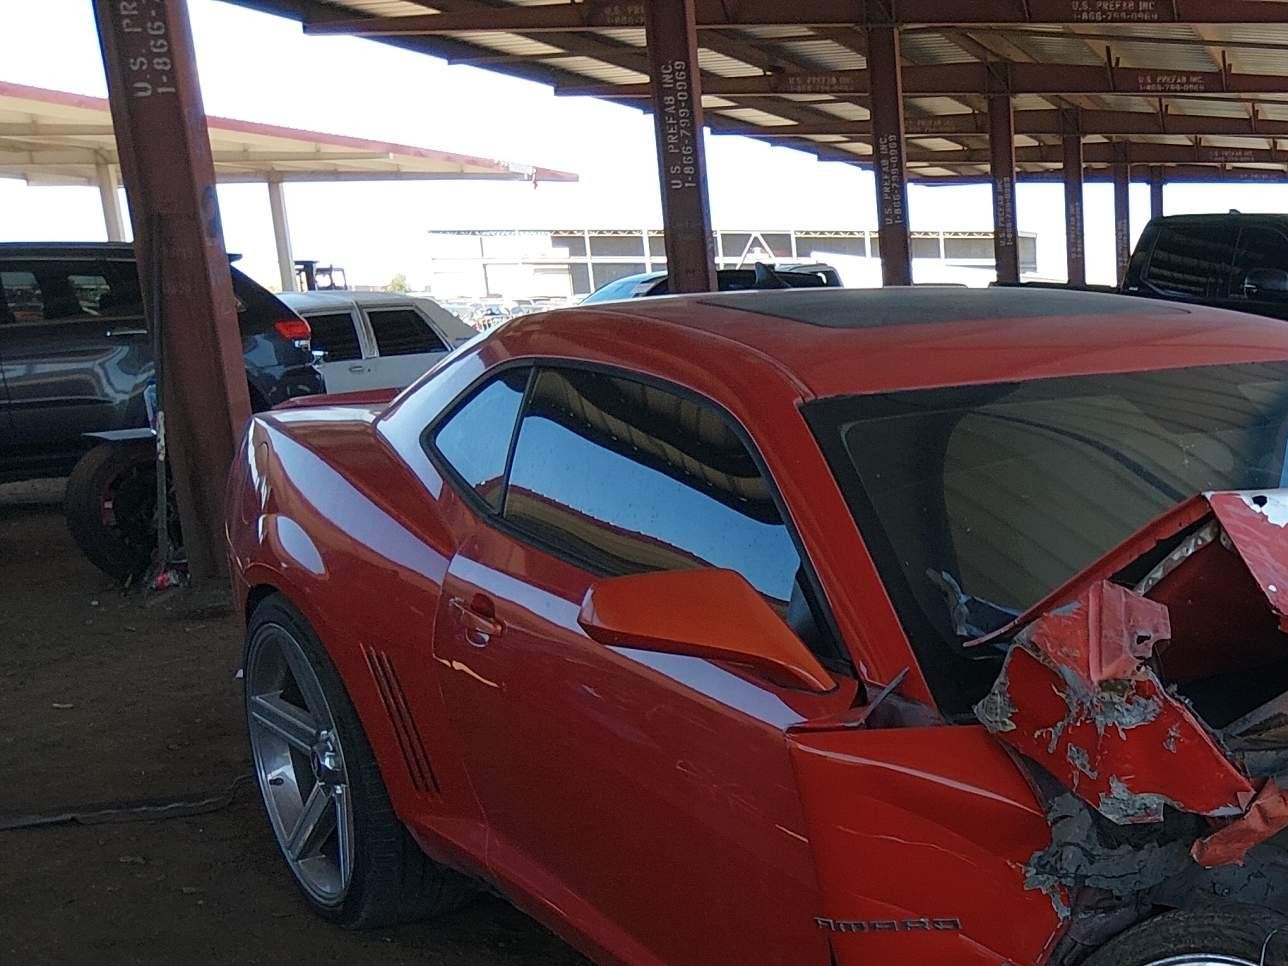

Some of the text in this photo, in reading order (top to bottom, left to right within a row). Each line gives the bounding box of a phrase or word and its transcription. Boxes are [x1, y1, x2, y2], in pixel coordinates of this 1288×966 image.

[129, 49, 153, 97] U.S.
[146, 0, 176, 93] 1-866-
[661, 59, 674, 89] INC.
[664, 95, 680, 153] PREFAB
[674, 60, 697, 188] 1-866-799-0969
